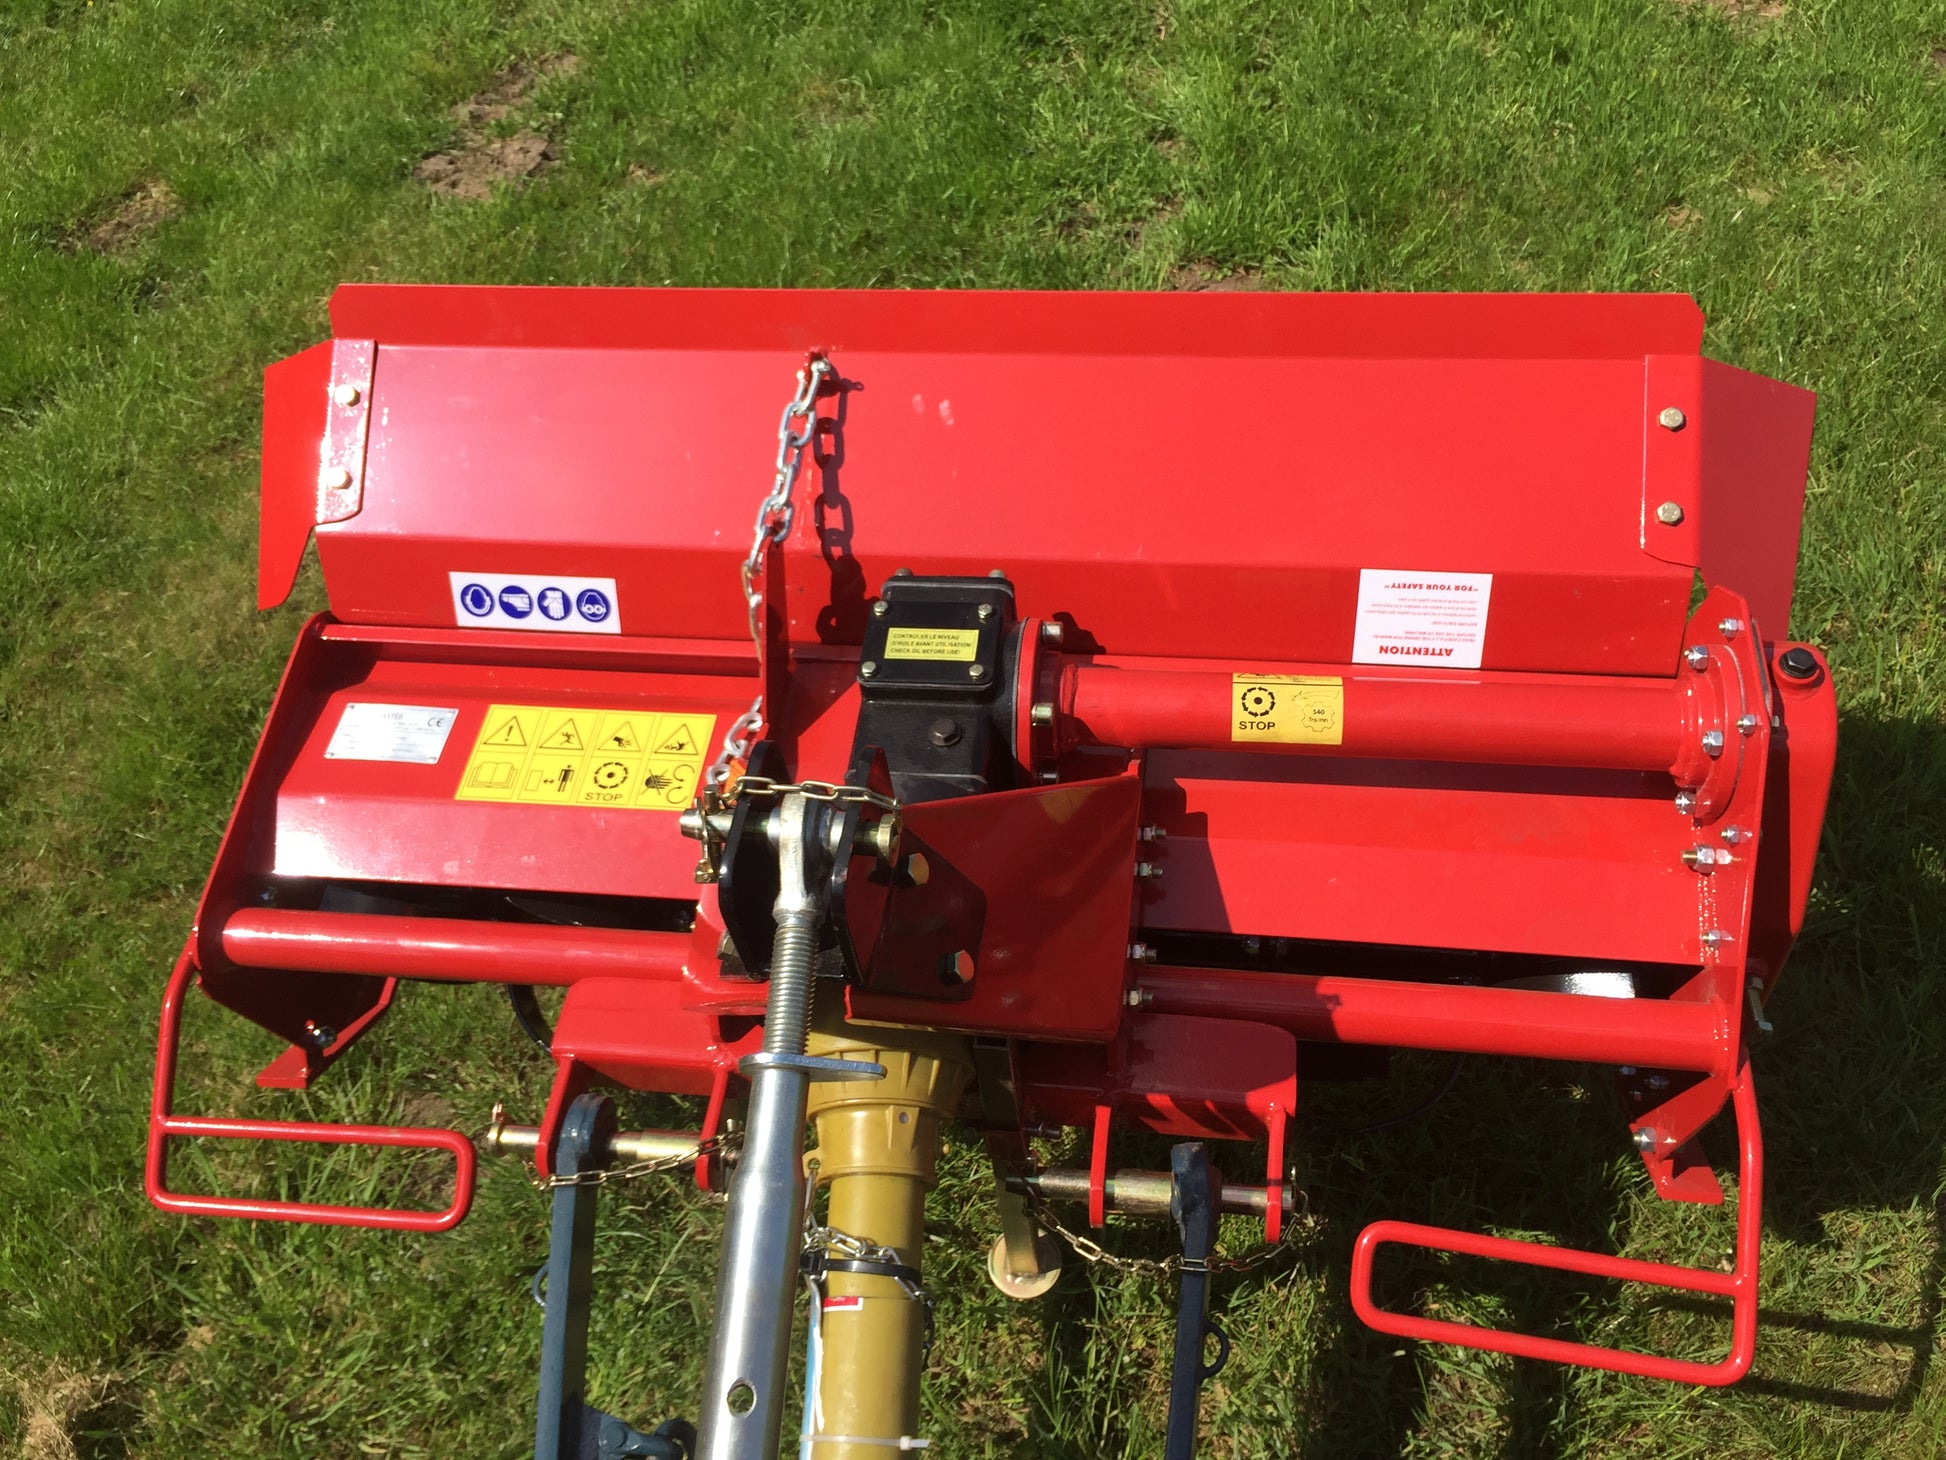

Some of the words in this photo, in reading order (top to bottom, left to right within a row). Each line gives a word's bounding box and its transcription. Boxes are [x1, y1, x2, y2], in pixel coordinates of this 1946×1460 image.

[1378, 645, 1454, 657] ATTENTION
[1238, 721, 1276, 730] STOP
[585, 792, 623, 801] STOP
